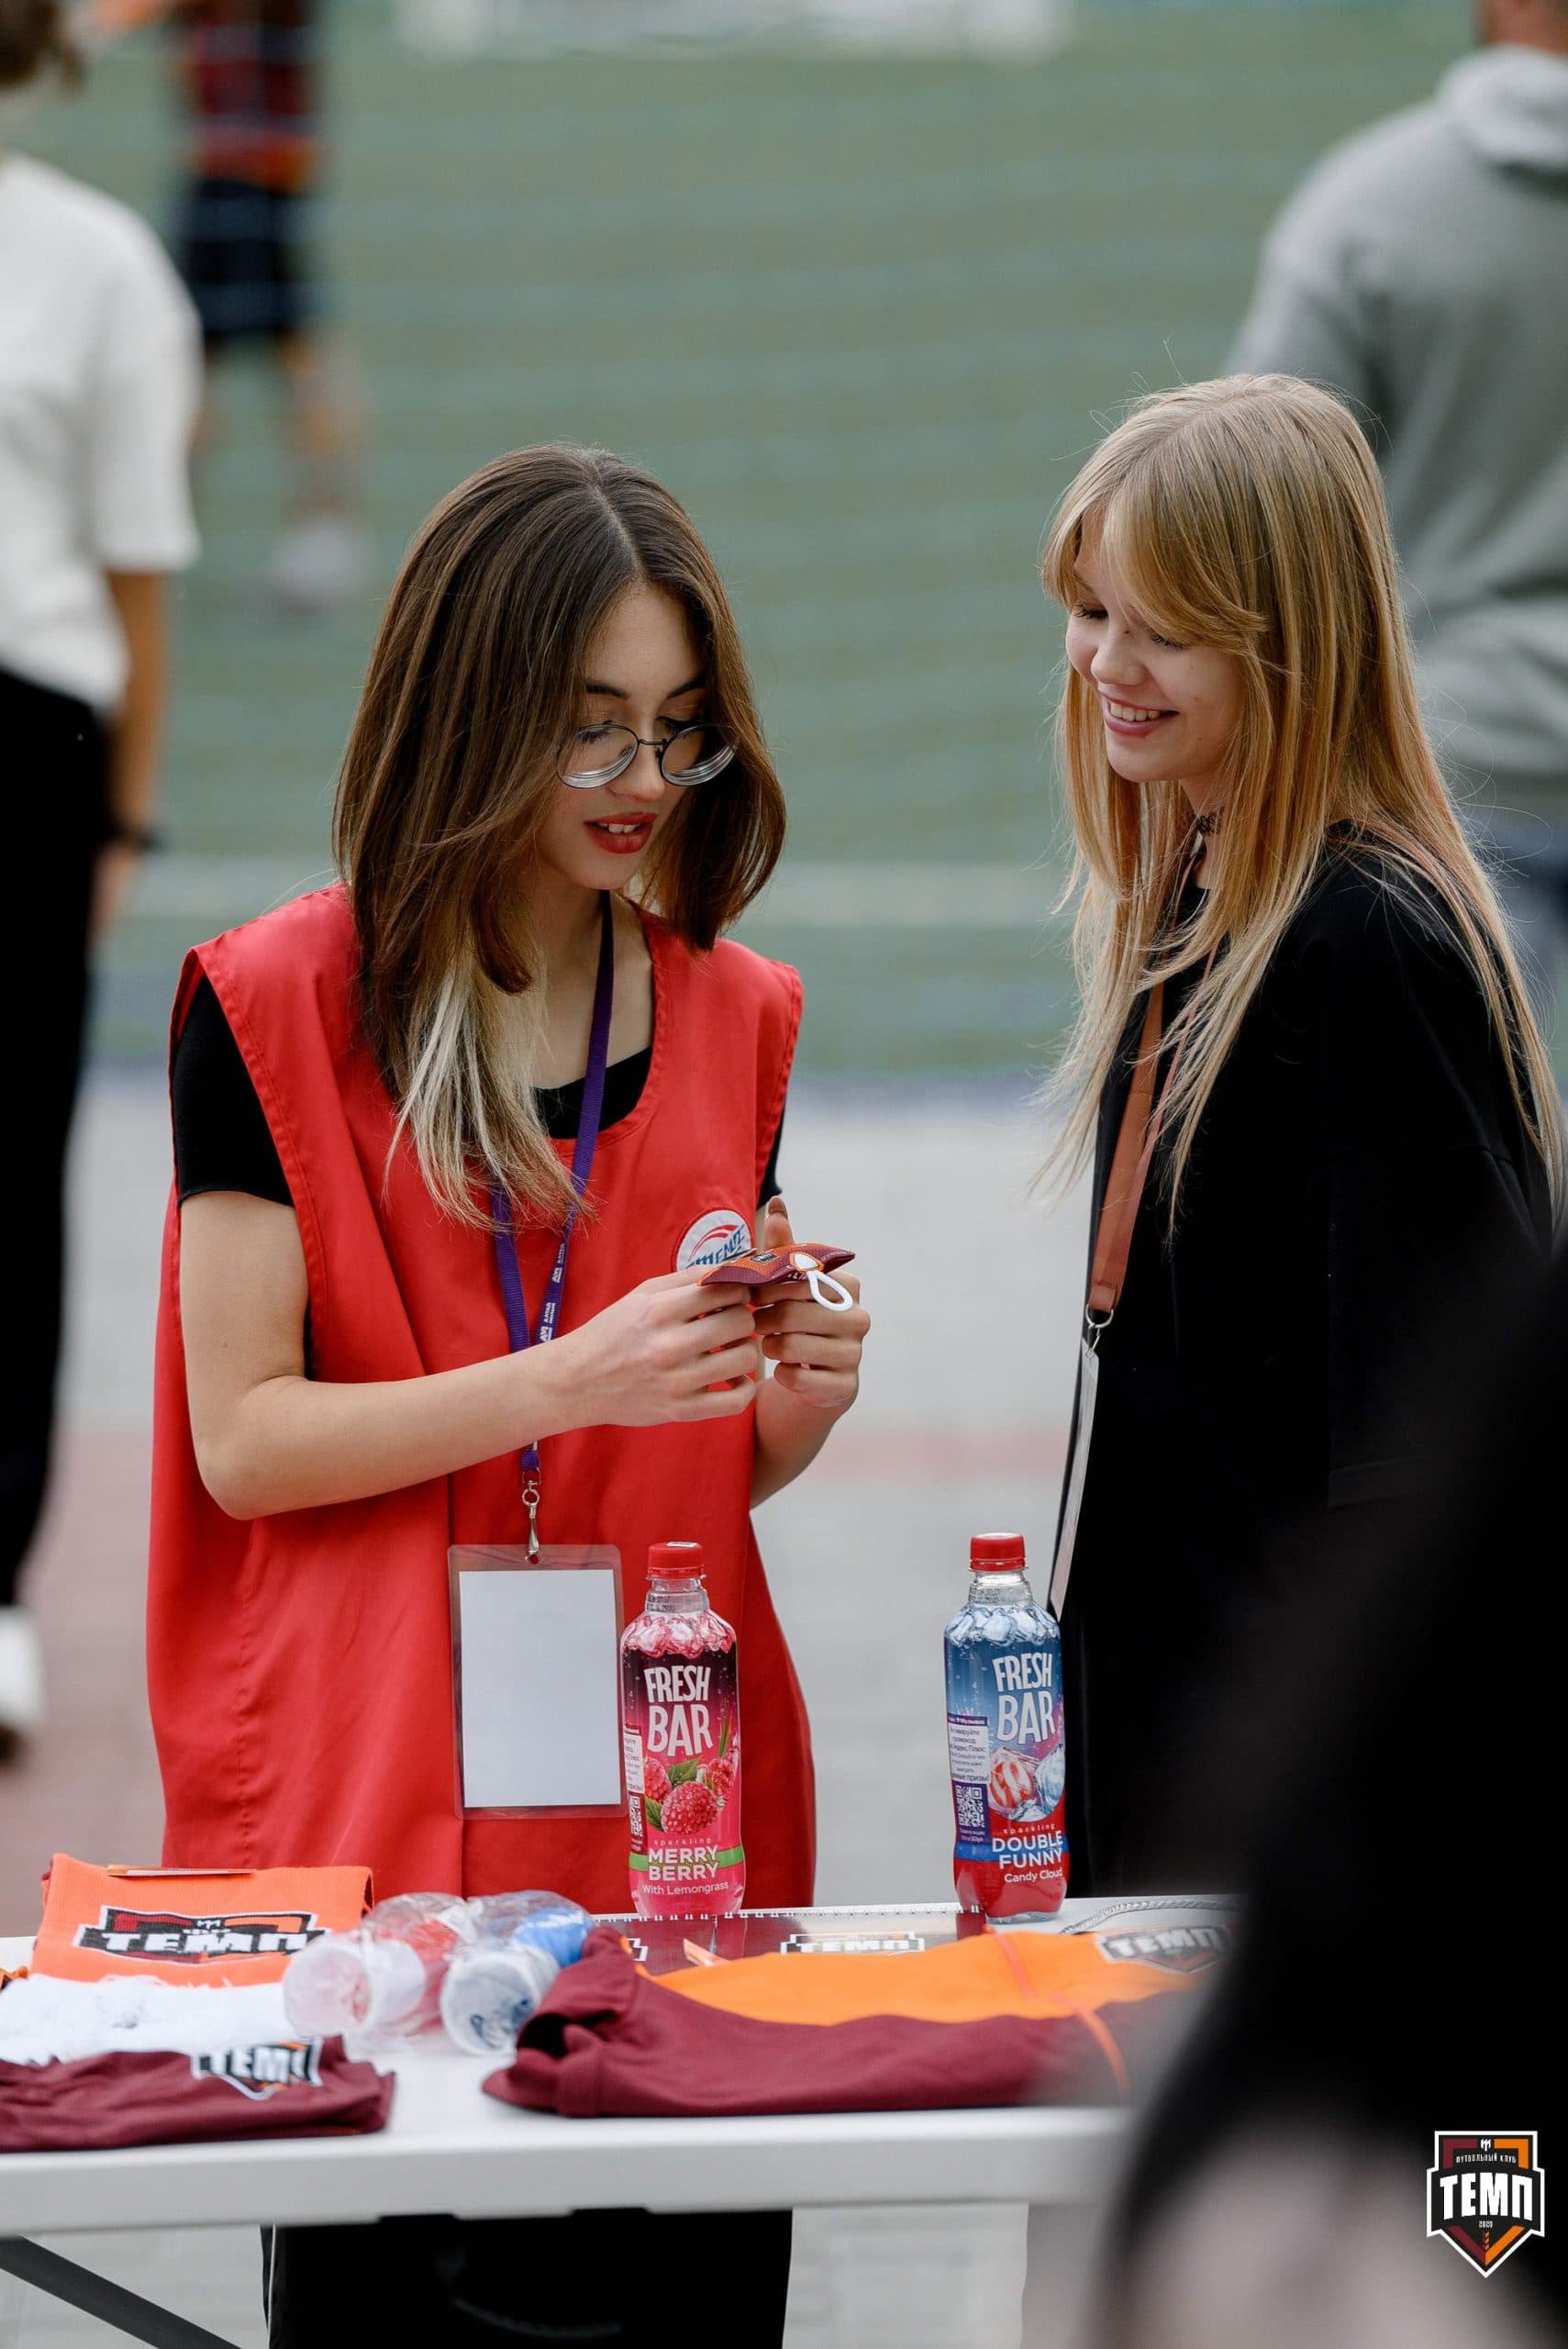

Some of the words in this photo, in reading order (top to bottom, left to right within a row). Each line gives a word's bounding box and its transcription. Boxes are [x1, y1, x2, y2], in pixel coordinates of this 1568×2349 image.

[992, 1652, 1053, 1692] FRESH
[644, 1664, 711, 1703] FRESH
[996, 1690, 1056, 1744] BAR
[647, 1703, 714, 1757] BAR
[1003, 1823, 1055, 1834] sparkling
[653, 1837, 712, 1845] sparkling
[992, 1831, 1063, 1853] DOUBLE
[649, 1844, 718, 1864] MERRY
[999, 1847, 1062, 1869] FUNNY
[649, 1862, 719, 1881] BERRY
[1004, 1871, 1038, 1883] Candy
[1040, 1867, 1063, 1880] Cloud
[642, 1884, 664, 1895] With
[667, 1881, 728, 1895] Lemongrass
[102, 1932, 307, 1953] ТЕМП
[1106, 1928, 1224, 1957] ТЕМП
